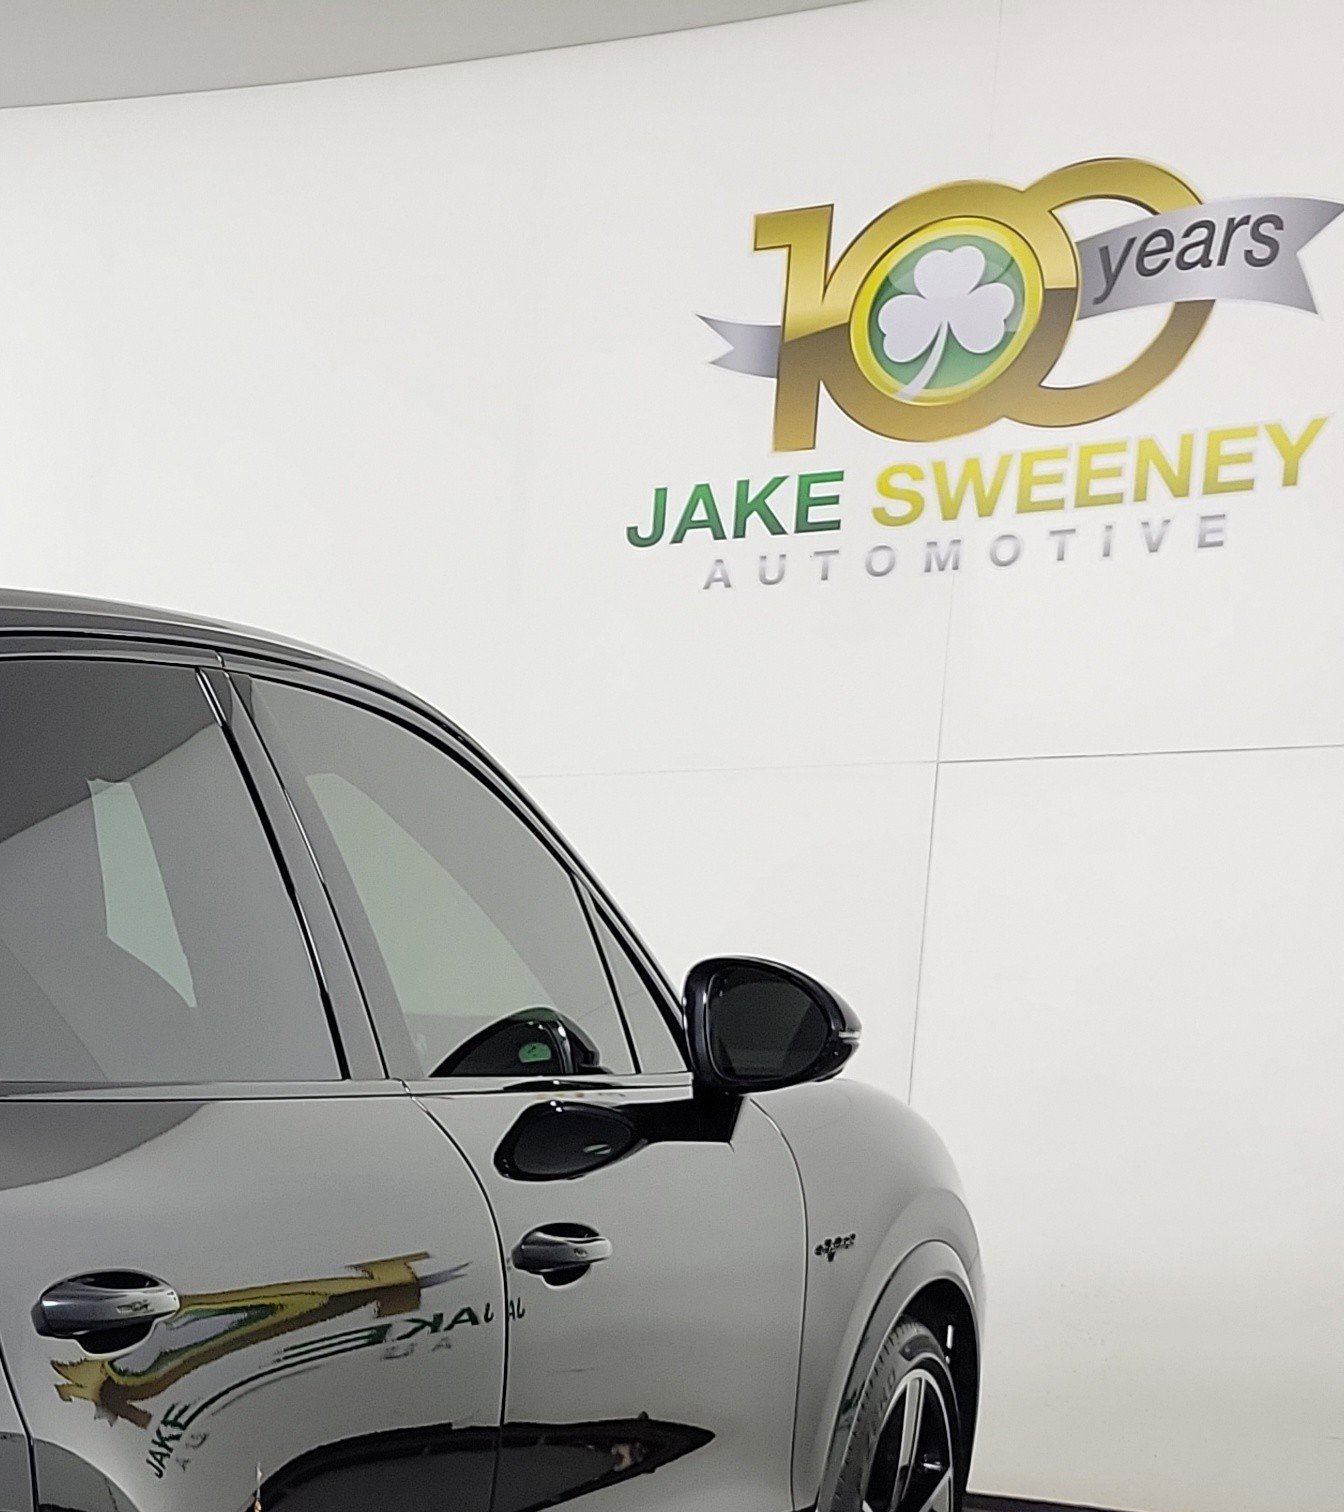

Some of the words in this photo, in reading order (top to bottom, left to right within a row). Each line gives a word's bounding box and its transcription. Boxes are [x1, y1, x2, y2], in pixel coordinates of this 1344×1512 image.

[753, 156, 1215, 452] 100
[1093, 212, 1284, 305] years
[626, 469, 846, 549] JAKE
[871, 415, 1330, 528] SWEENEY
[702, 513, 1228, 591] AUTOMOTIVE
